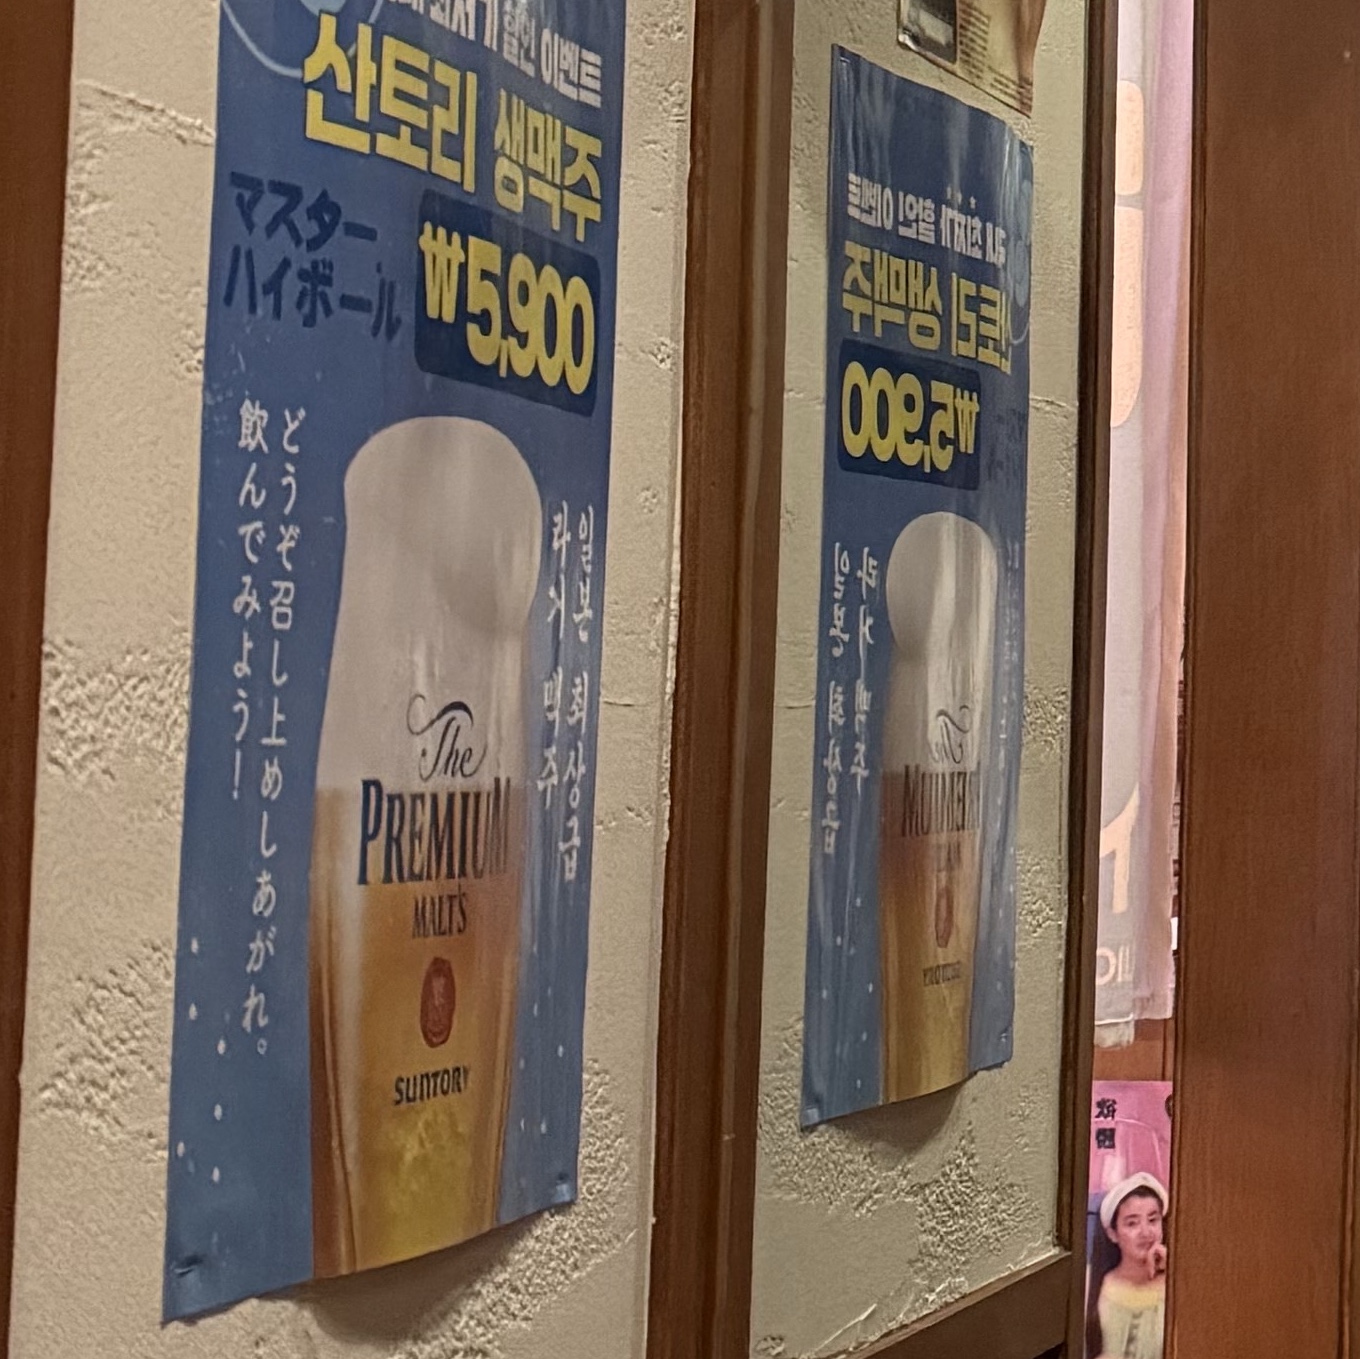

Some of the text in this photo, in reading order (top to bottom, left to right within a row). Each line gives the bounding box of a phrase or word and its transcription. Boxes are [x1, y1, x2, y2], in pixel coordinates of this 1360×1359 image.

[540, 27, 603, 110] 이벤트
[302, 11, 602, 242] 산토리 생맥주
[228, 170, 379, 252] マスター
[222, 244, 402, 341] ハイボール
[418, 220, 596, 396] ₩5,900
[407, 693, 486, 782] The
[558, 503, 595, 883] 일본 최상급
[357, 777, 512, 888] PREMIUM
